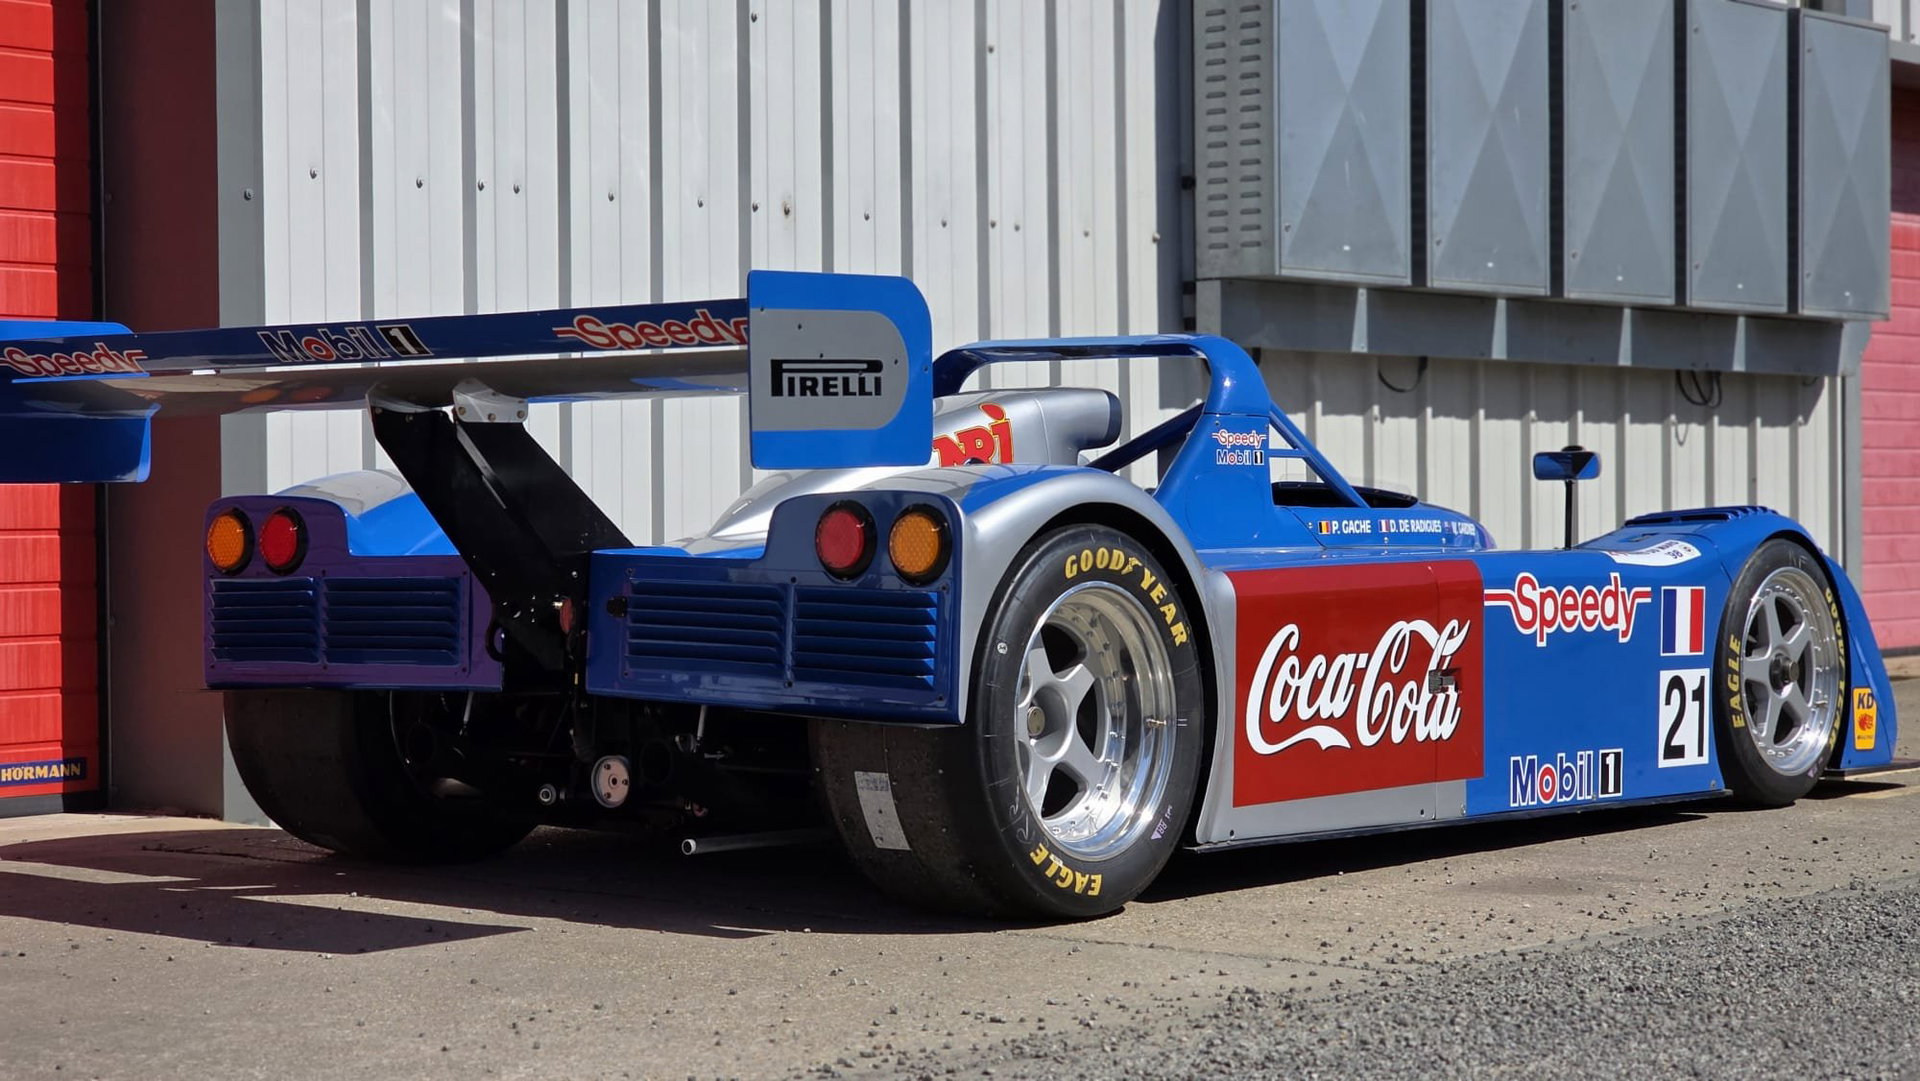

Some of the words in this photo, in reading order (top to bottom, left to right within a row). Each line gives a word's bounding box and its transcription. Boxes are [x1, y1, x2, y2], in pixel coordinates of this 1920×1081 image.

[257, 327, 391, 362] Mobil
[557, 308, 747, 350] Speedy
[0, 342, 148, 376] Speedy
[771, 359, 883, 397] PIRELLI
[1212, 429, 1266, 449] Speedy
[1217, 449, 1252, 465] Mobil
[1332, 521, 1341, 534] P.
[1342, 520, 1372, 535] GACHE
[1390, 521, 1399, 533] D.
[1400, 520, 1410, 533] DE
[1411, 519, 1442, 533] RADIGUES
[1065, 547, 1187, 647] GOODYEAR
[1484, 572, 1651, 647] Speedy
[1246, 619, 1470, 754] Coca-Cola
[1728, 634, 1741, 729] EAGLE
[1663, 674, 1704, 762] 21
[1858, 693, 1874, 709] KD
[1, 763, 81, 782] HÖRMANN
[1510, 751, 1594, 807] Mobil
[1600, 750, 1622, 797] 1
[1030, 843, 1102, 896] EAGLE
